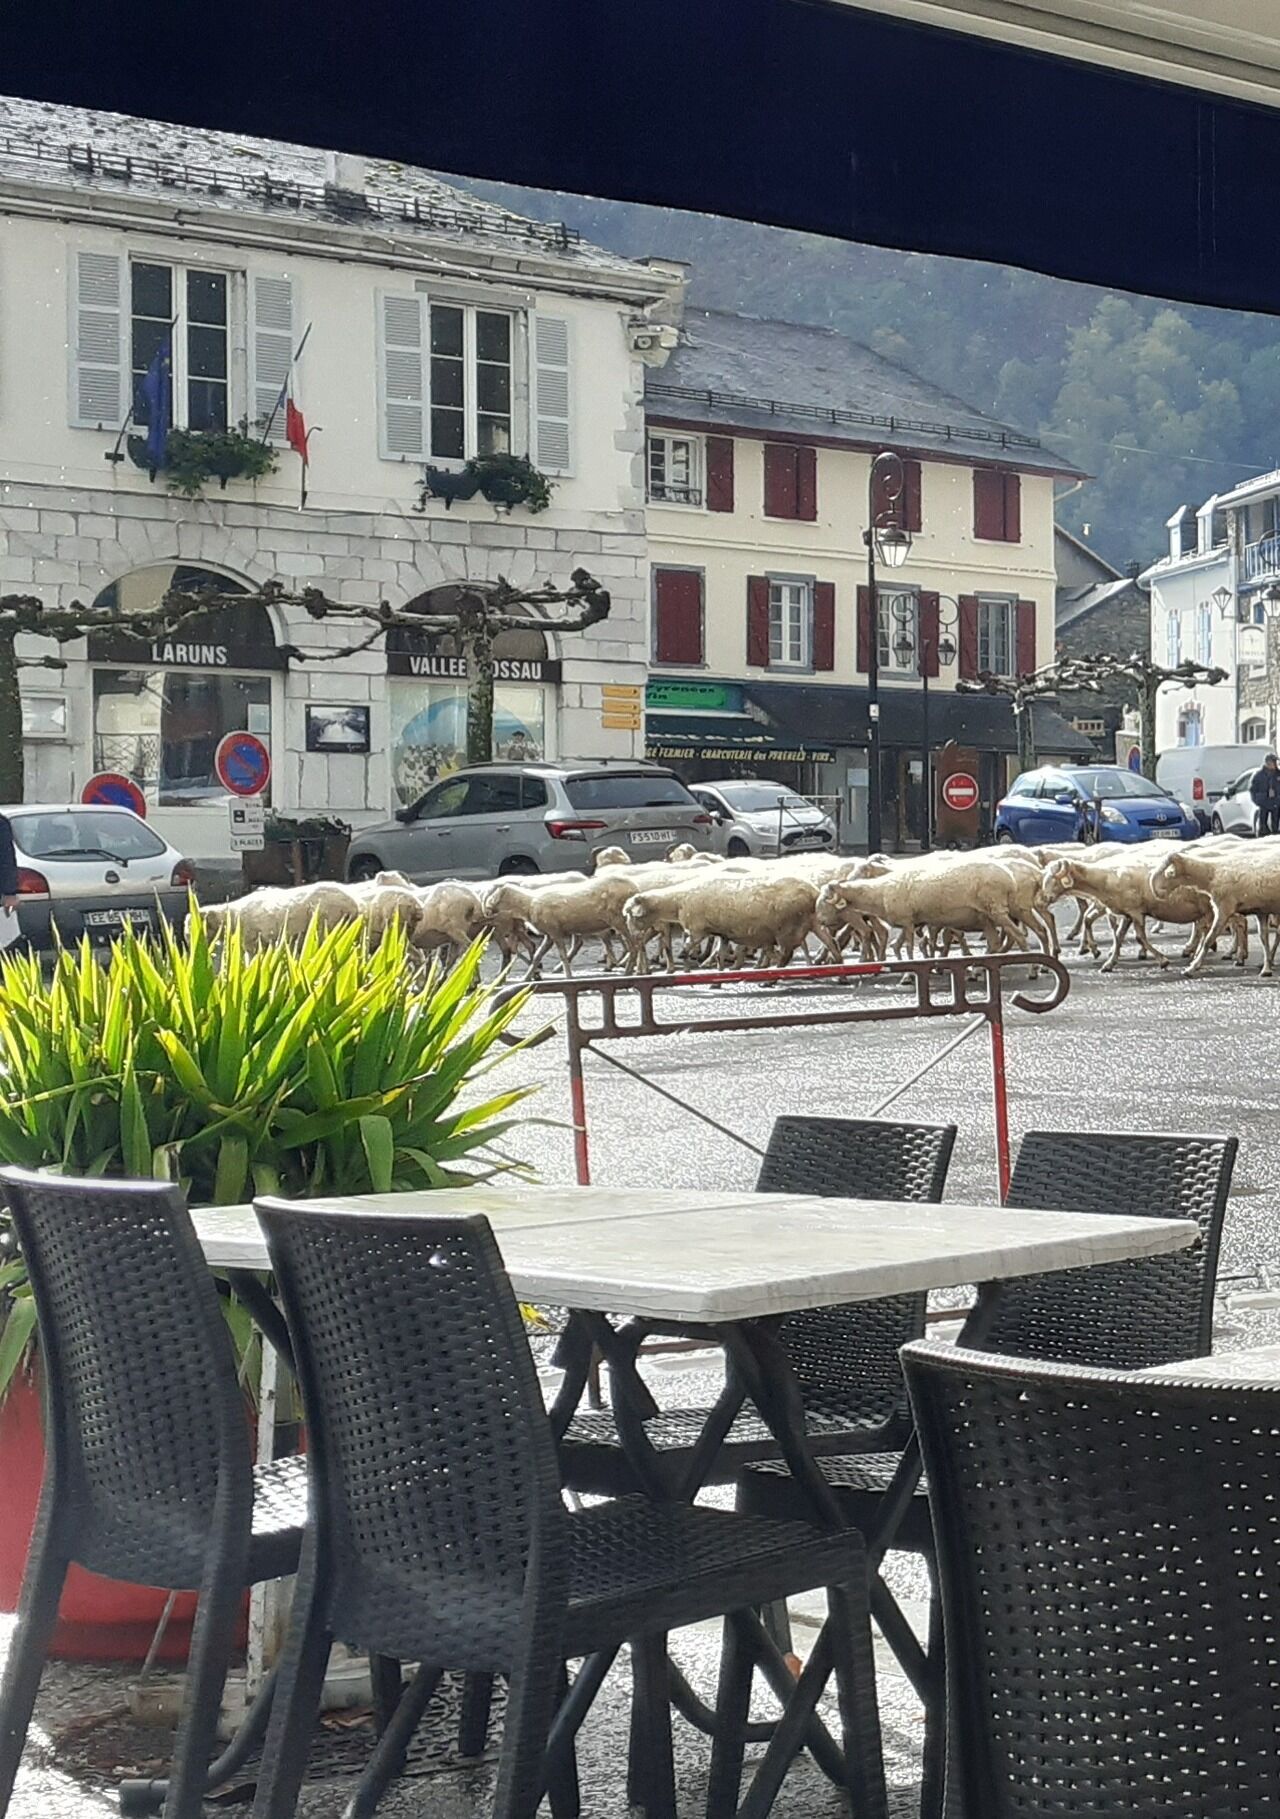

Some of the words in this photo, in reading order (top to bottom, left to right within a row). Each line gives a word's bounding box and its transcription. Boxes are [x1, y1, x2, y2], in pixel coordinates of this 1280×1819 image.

[151, 642, 228, 665] LARUNS
[409, 656, 467, 676] VALLEE
[659, 748, 695, 759] FERMIER
